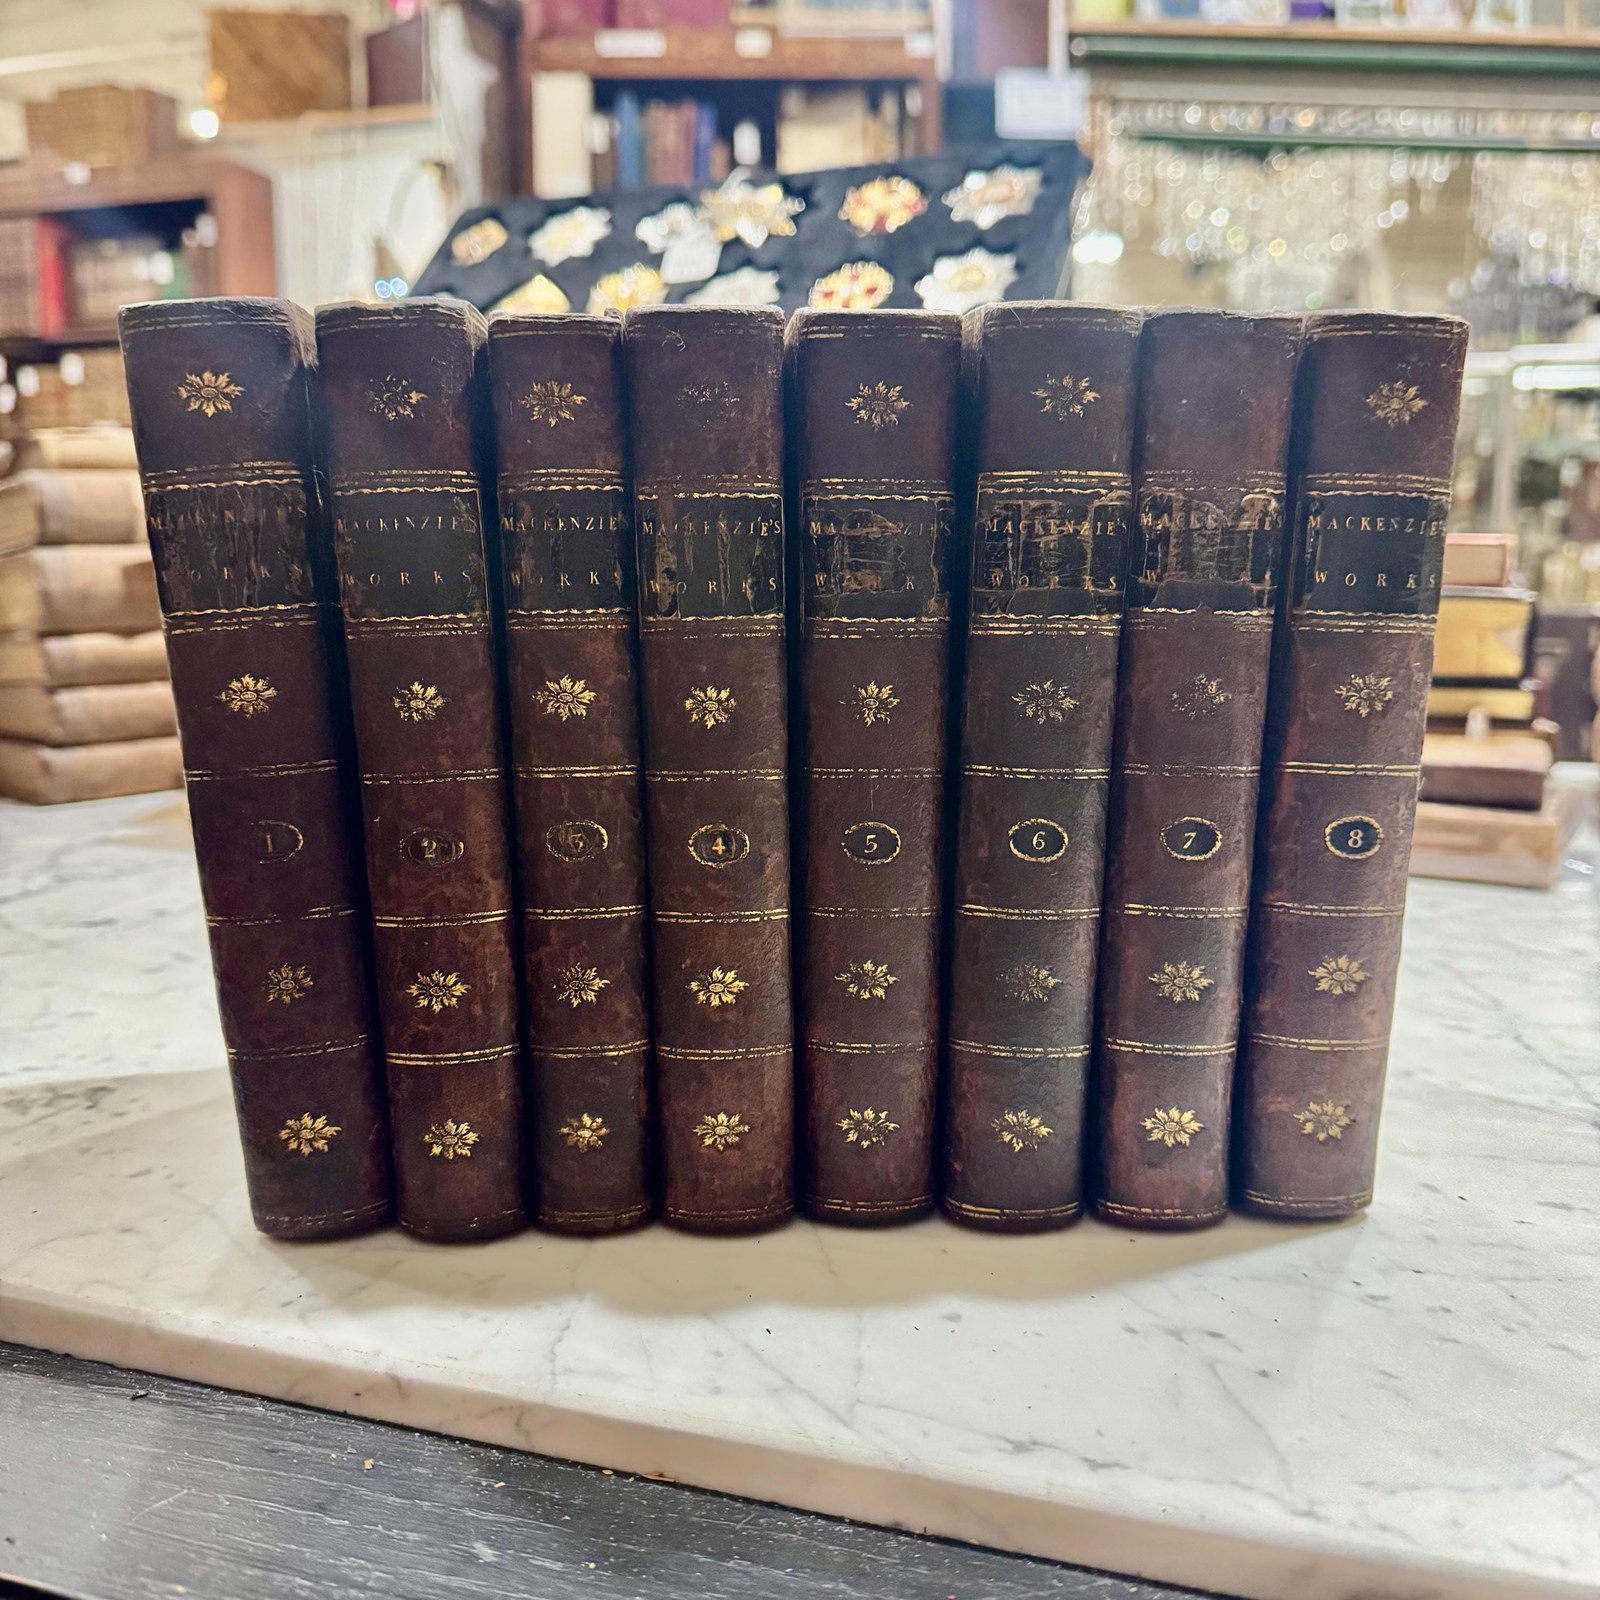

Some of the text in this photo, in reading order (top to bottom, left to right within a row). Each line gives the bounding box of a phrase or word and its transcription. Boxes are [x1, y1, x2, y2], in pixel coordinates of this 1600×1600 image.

[1314, 570, 1438, 589] WORKS
[421, 837, 437, 860] 2
[711, 835, 726, 856] 4
[864, 833, 878, 854] 5
[1031, 830, 1047, 850] 6
[1181, 831, 1198, 850] 7
[1347, 829, 1364, 849] 8
